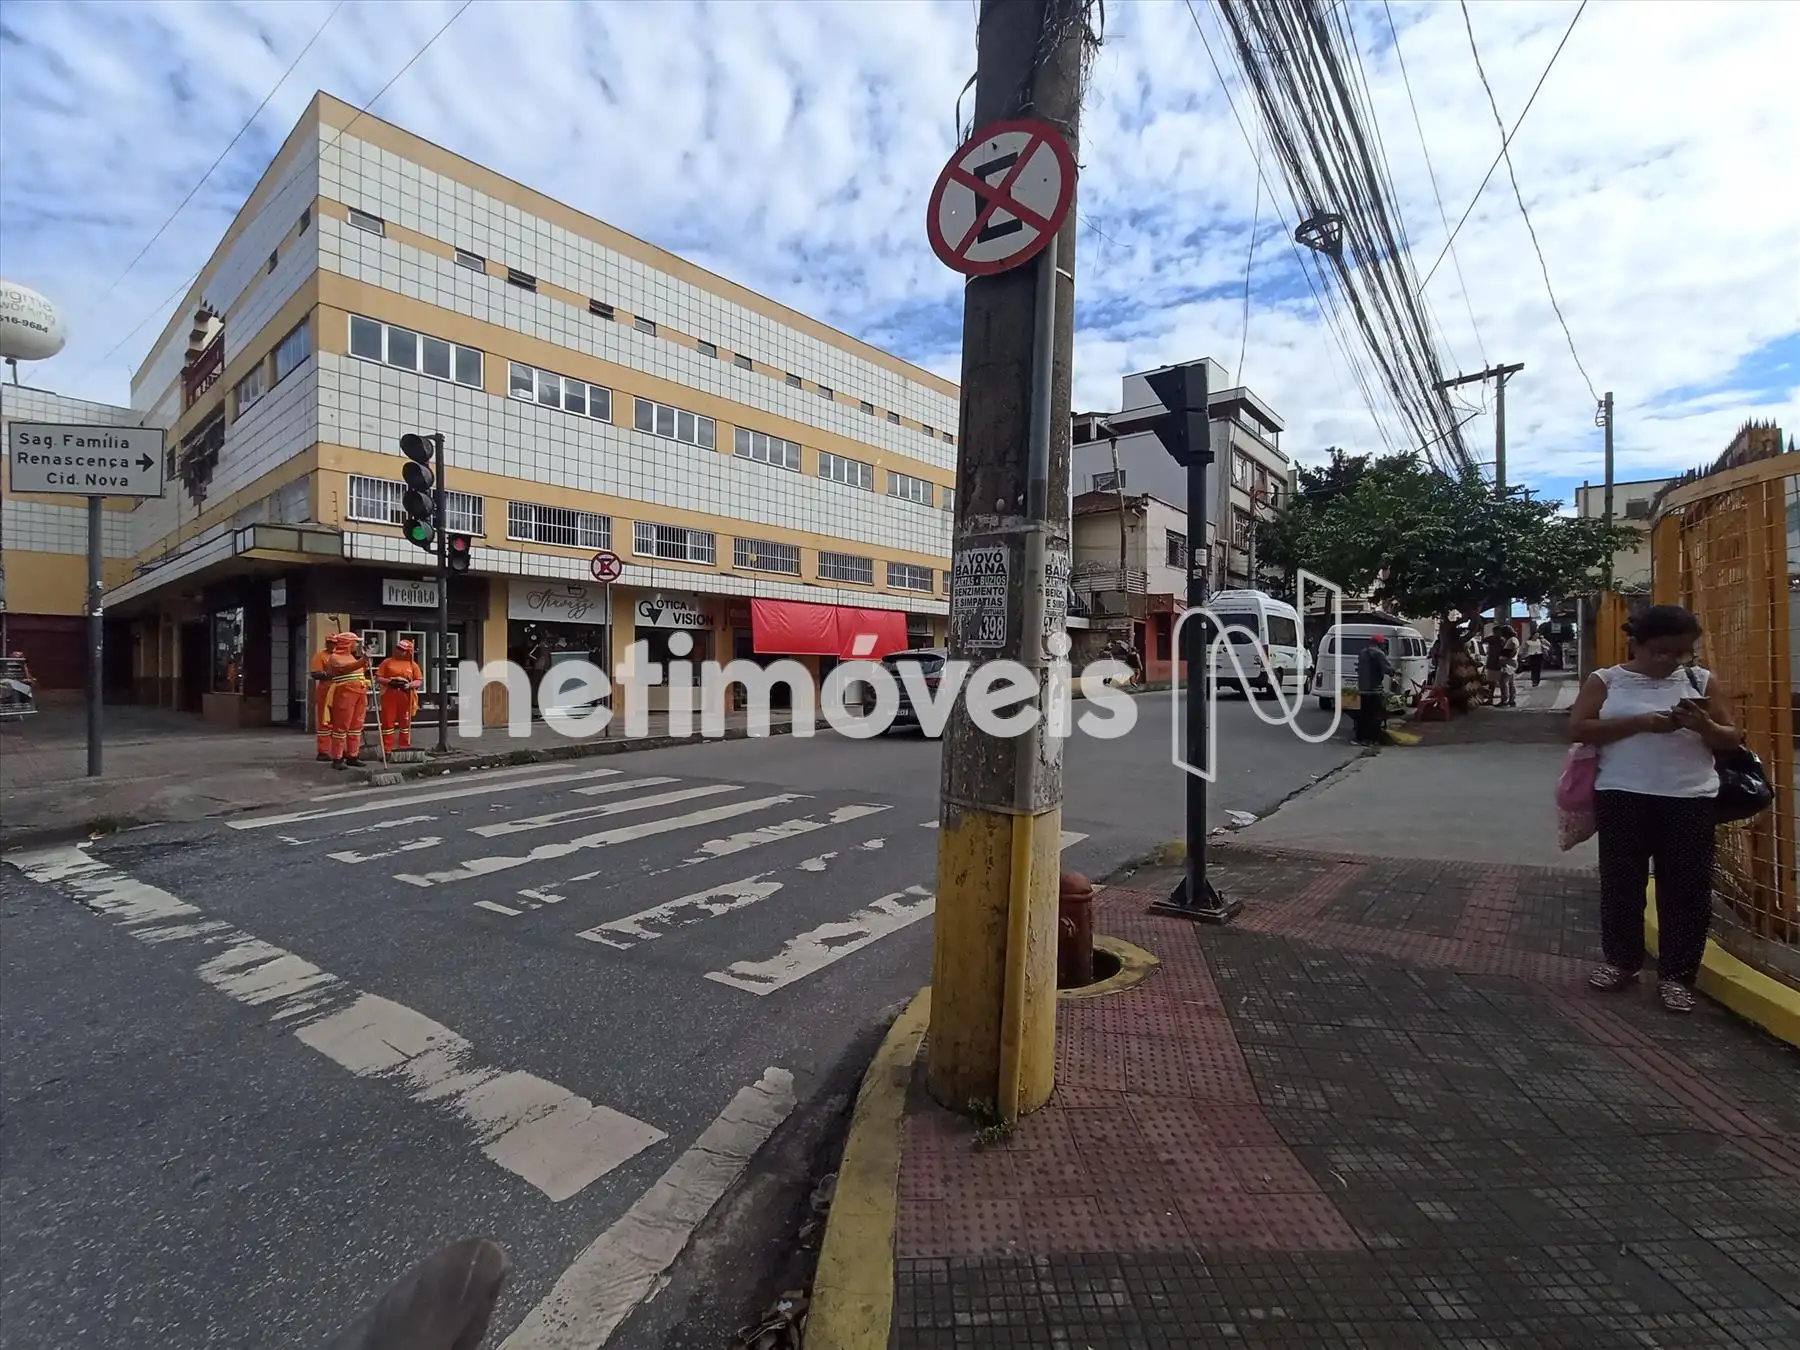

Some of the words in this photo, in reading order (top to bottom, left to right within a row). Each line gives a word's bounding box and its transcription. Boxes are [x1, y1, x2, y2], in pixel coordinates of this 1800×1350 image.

[19, 433, 57, 449] Sag.
[63, 433, 130, 449] Família
[17, 452, 129, 468] Renascença
[46, 472, 79, 485] Cid.
[85, 473, 129, 487] Nova
[968, 550, 1003, 564] VOVÓ
[955, 563, 1007, 576] BAIANA
[954, 586, 1005, 597] BENZIMENTO
[955, 598, 960, 608] E
[960, 597, 1003, 607] SIMPATIAS
[673, 612, 714, 626] VISION
